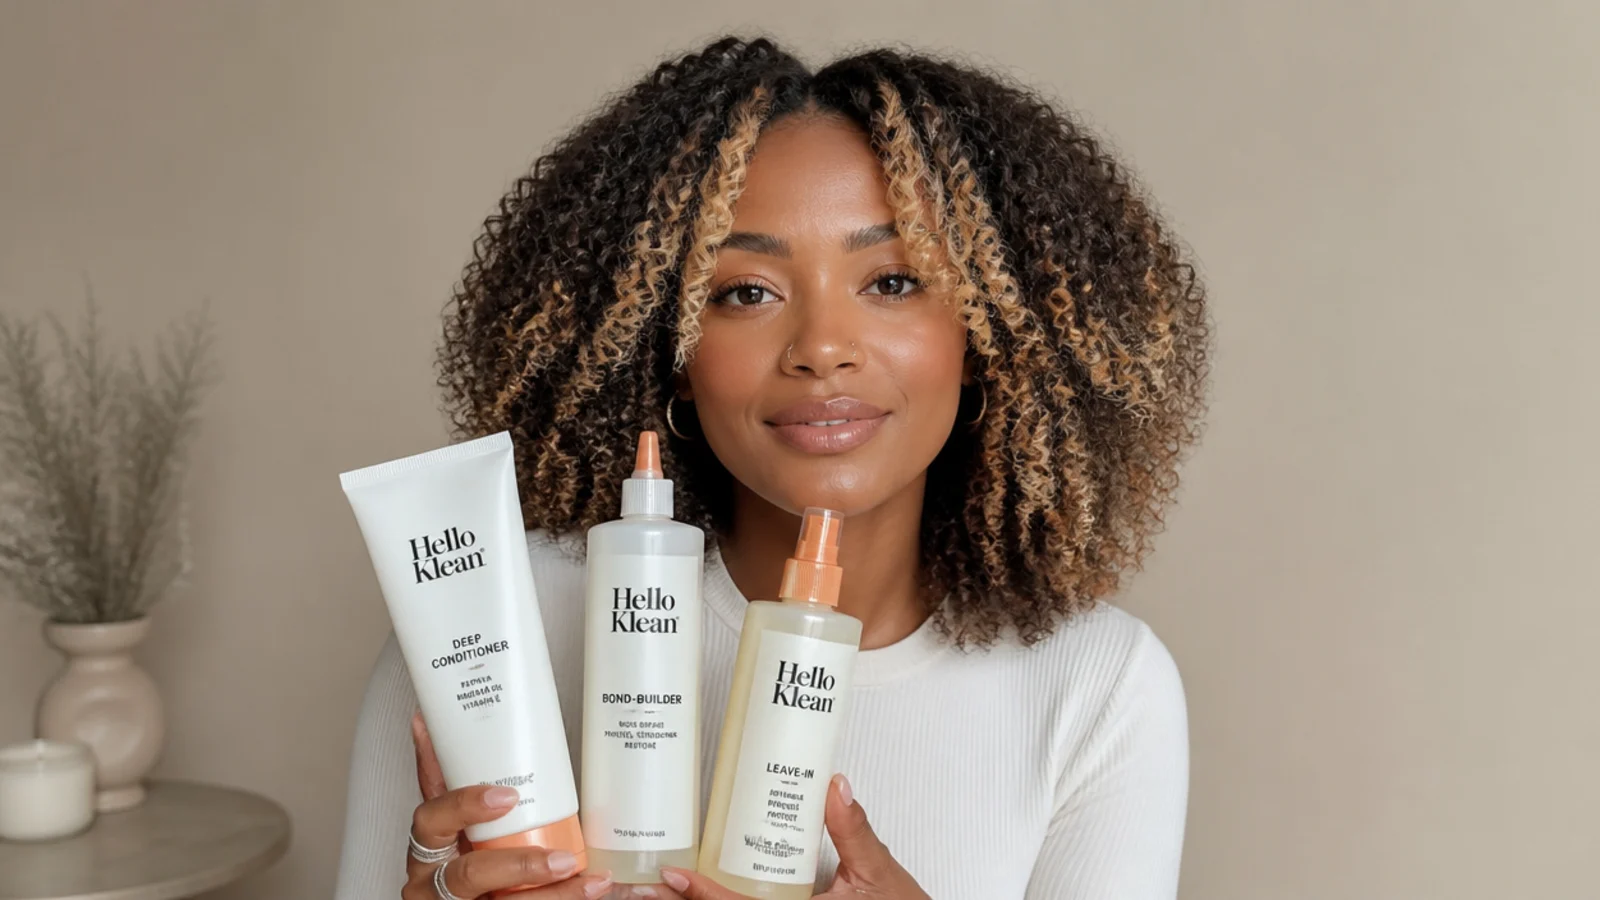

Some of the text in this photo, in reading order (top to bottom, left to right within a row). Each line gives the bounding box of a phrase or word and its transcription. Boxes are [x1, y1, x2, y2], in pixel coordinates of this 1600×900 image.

[408, 526, 476, 561] Hello
[412, 549, 487, 584] Klean
[612, 587, 676, 611] Hello
[611, 610, 680, 634] Klean
[452, 633, 481, 649] DEEP
[431, 640, 509, 669] CONDITIONER
[776, 659, 836, 691] Hello
[602, 693, 682, 704] BOND-BUILDER
[771, 682, 836, 713] Klean
[766, 762, 814, 779] LEAVE-IN
